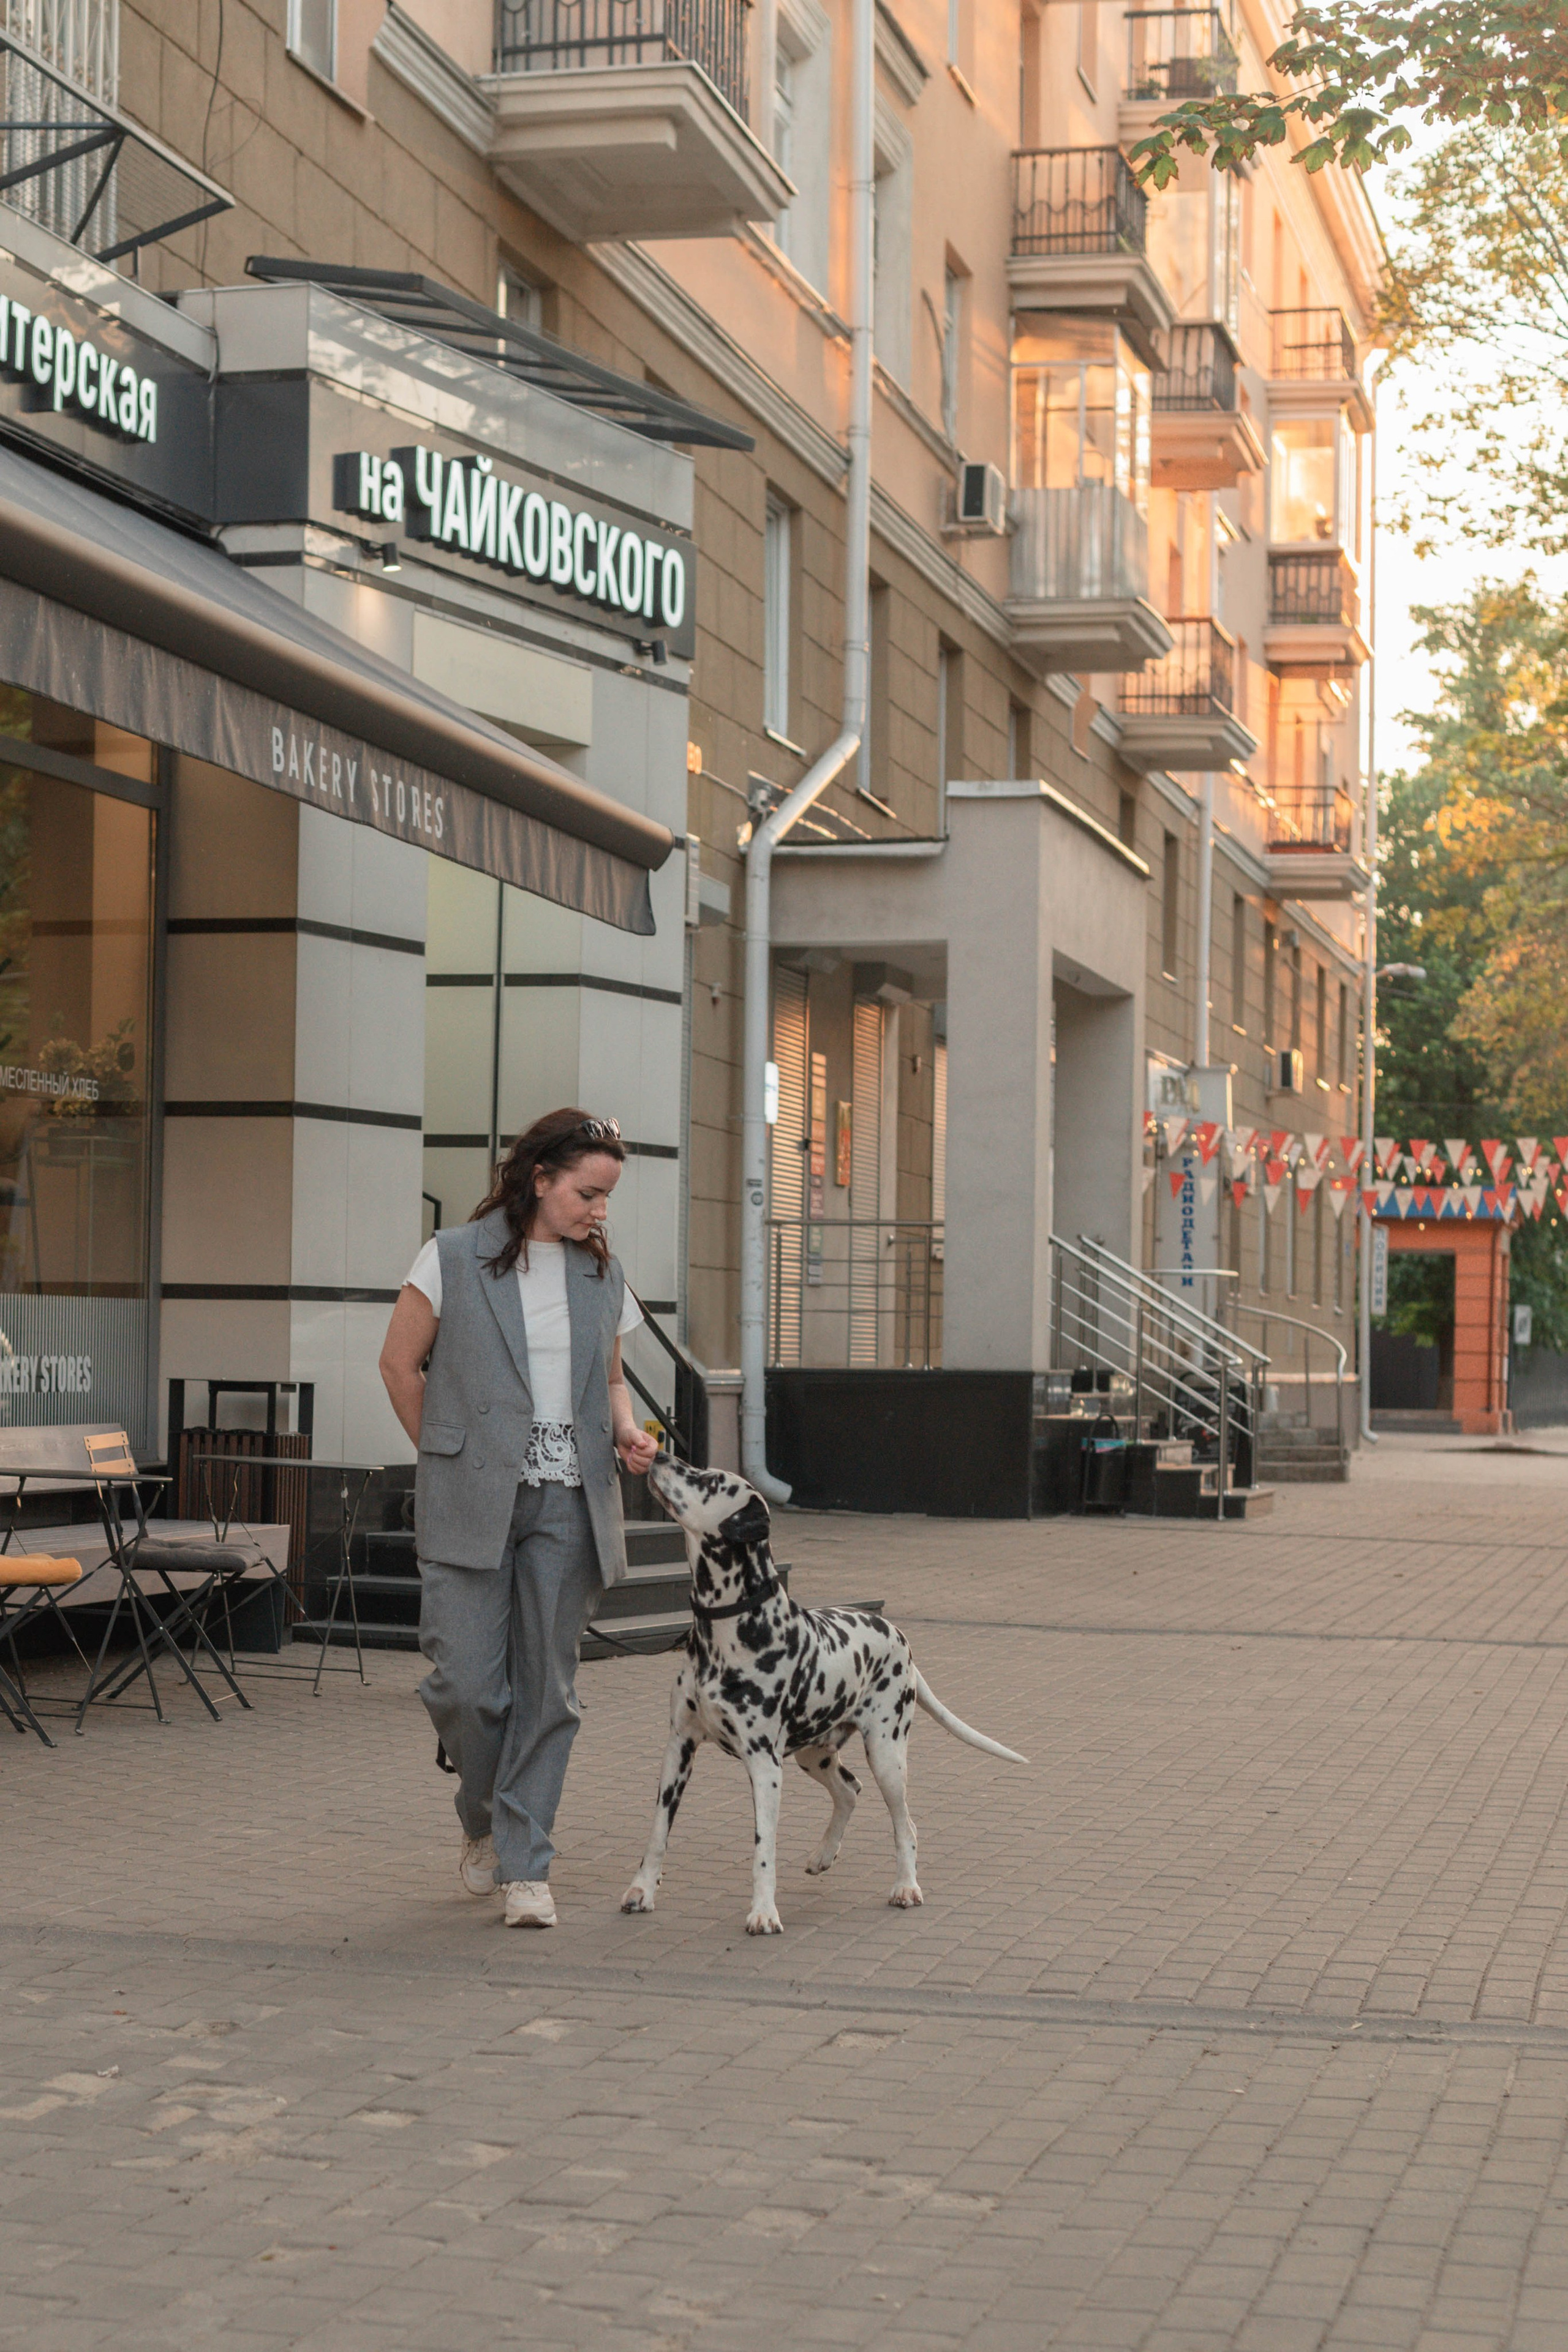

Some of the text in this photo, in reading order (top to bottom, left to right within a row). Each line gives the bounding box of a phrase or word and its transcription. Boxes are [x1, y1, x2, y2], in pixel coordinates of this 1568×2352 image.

[360, 445, 685, 628] на ЧАЙКОВСКОГО
[272, 726, 443, 839] BAKERY STORES
[72, 1076, 99, 1100] ХЛЕБ
[40, 1354, 91, 1393] STORES
